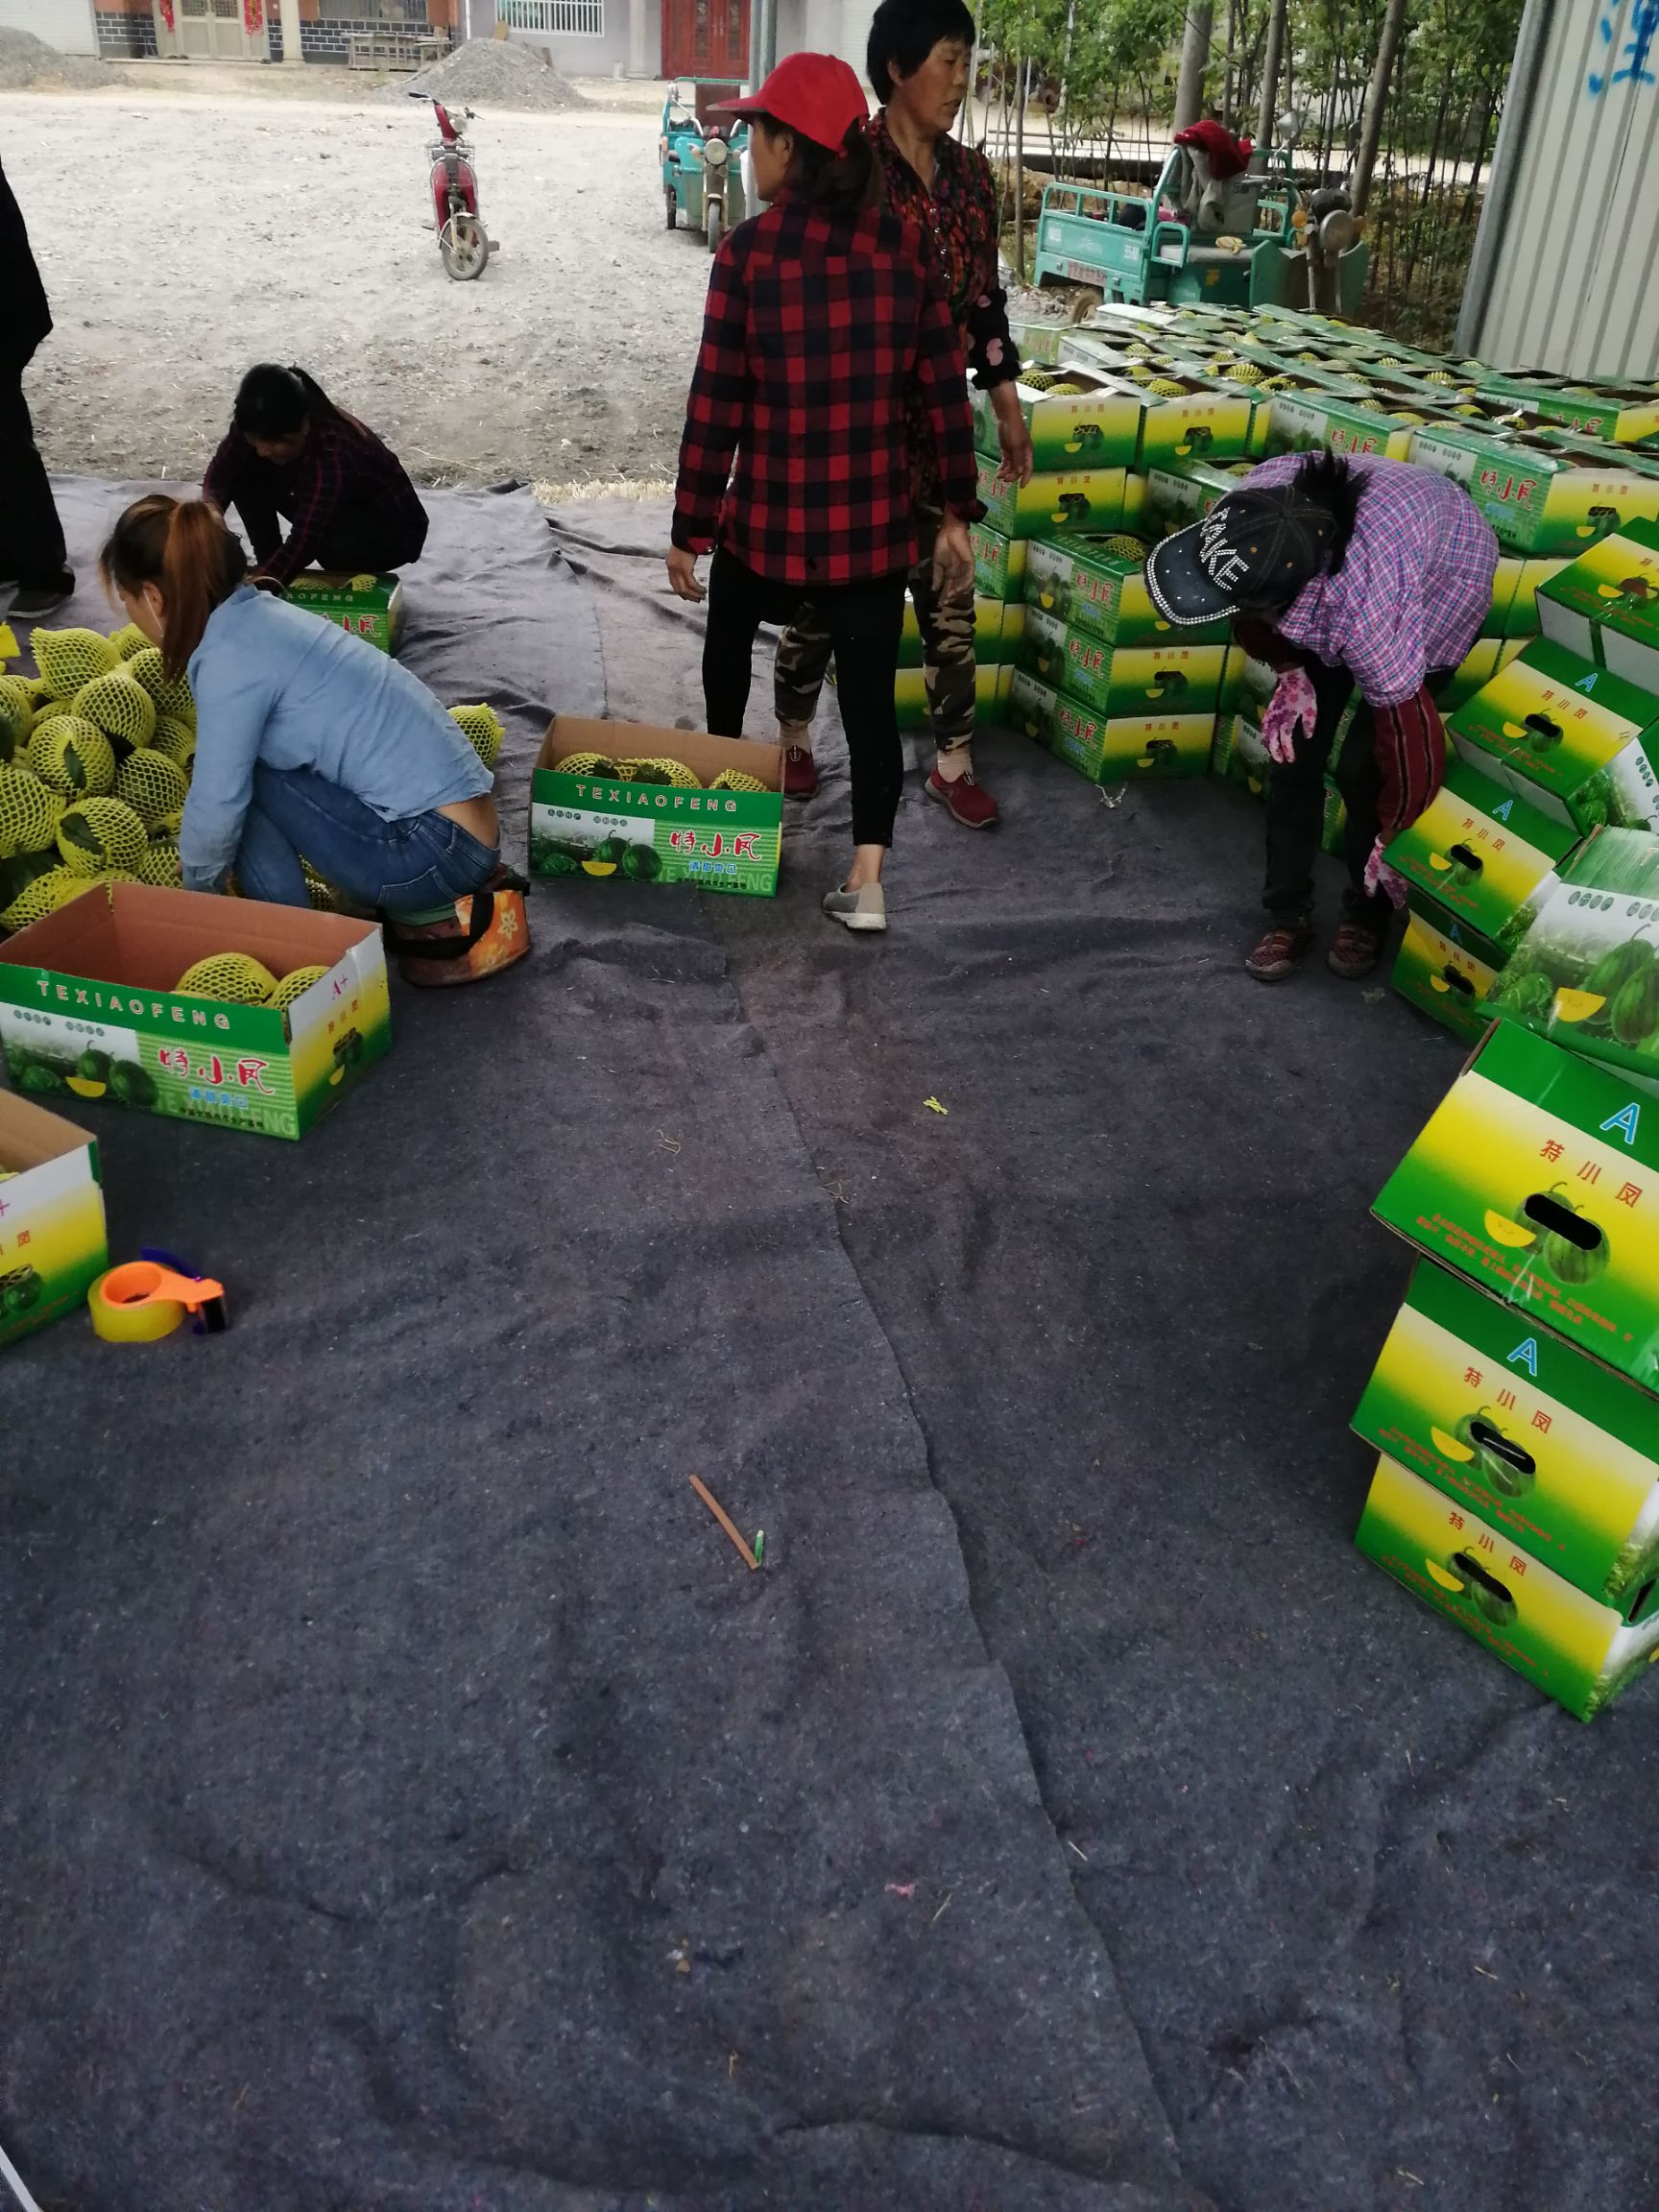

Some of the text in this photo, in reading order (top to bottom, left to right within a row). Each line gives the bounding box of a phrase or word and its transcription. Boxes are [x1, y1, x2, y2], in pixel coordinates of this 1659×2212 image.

[1480, 469, 1536, 512] 特小凤
[1574, 672, 1599, 692] A
[576, 784, 737, 811] TEXIAOFENG
[1492, 799, 1514, 821] A
[670, 830, 762, 860] 特小凤
[1450, 924, 1463, 945] A
[36, 980, 230, 1030] TEXIAOFENG
[158, 1047, 275, 1094] 特小凤
[1599, 1102, 1641, 1145] A
[1539, 1139, 1644, 1208] 特小凤
[1507, 1337, 1538, 1377] A
[1463, 1366, 1552, 1434] 特小凤
[1448, 1511, 1527, 1577] 特小凤
